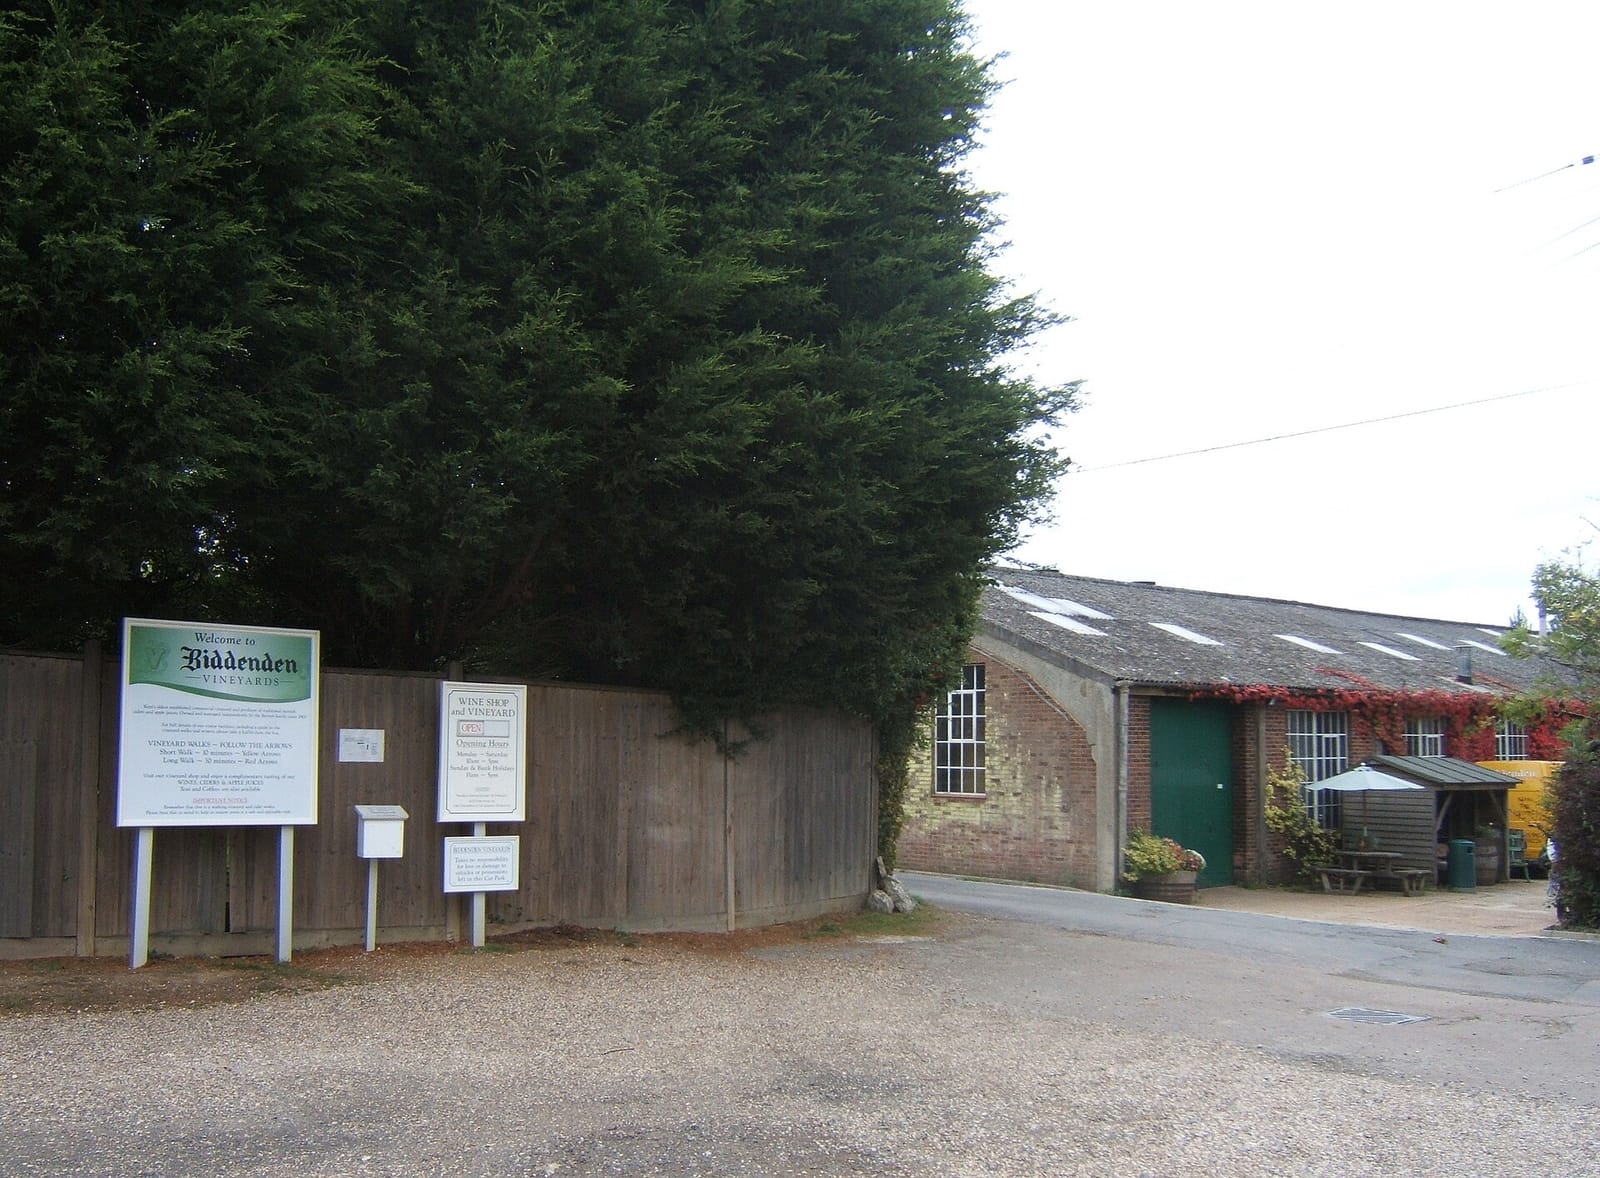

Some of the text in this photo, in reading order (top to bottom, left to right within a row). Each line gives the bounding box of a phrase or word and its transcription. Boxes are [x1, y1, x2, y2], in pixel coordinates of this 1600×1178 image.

[195, 633, 256, 645] Welcome to
[180, 646, 298, 674] Biddenden
[202, 674, 280, 686] VINEYARDS
[458, 697, 509, 706] WINE SHOP
[468, 708, 515, 717] VINEYARD
[462, 724, 481, 732] OPEN
[456, 739, 486, 748] Opening
